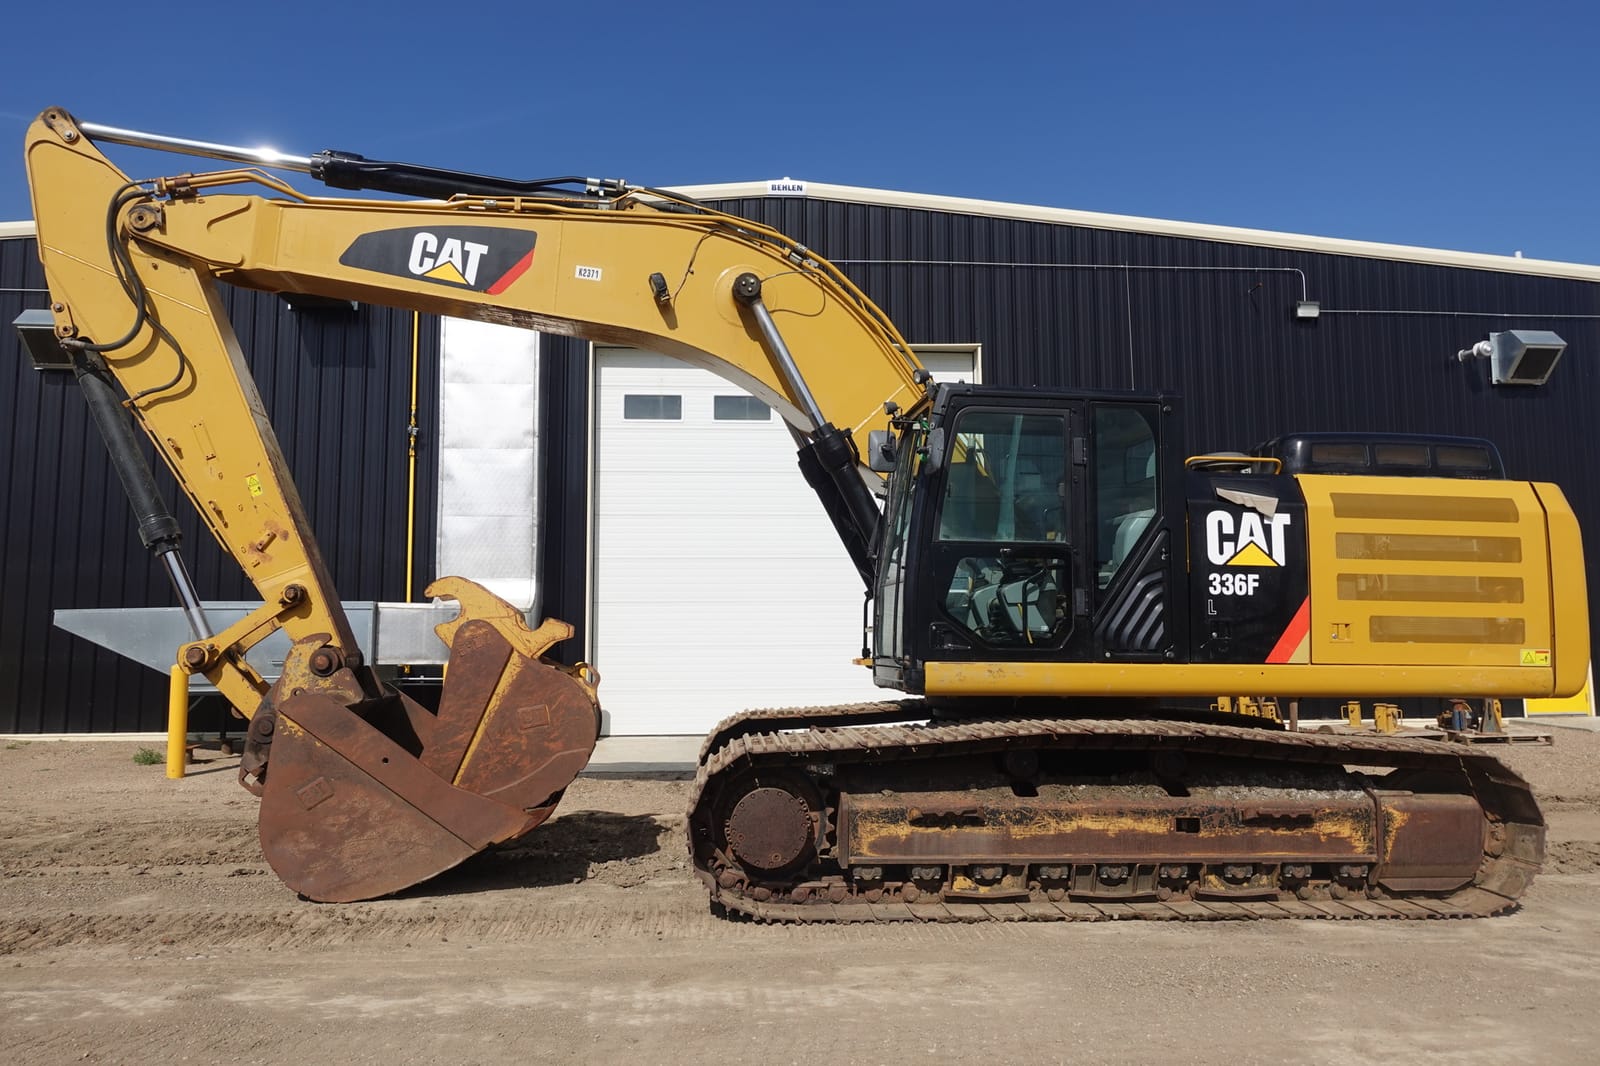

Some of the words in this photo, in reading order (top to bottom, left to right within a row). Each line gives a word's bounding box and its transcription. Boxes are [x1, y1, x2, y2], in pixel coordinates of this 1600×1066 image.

[771, 184, 803, 192] BEHLEN
[408, 231, 489, 286] CAT
[578, 267, 599, 279] K2371
[1206, 510, 1291, 567] CAT
[1208, 573, 1260, 596] 336F
[1207, 599, 1217, 615] L
